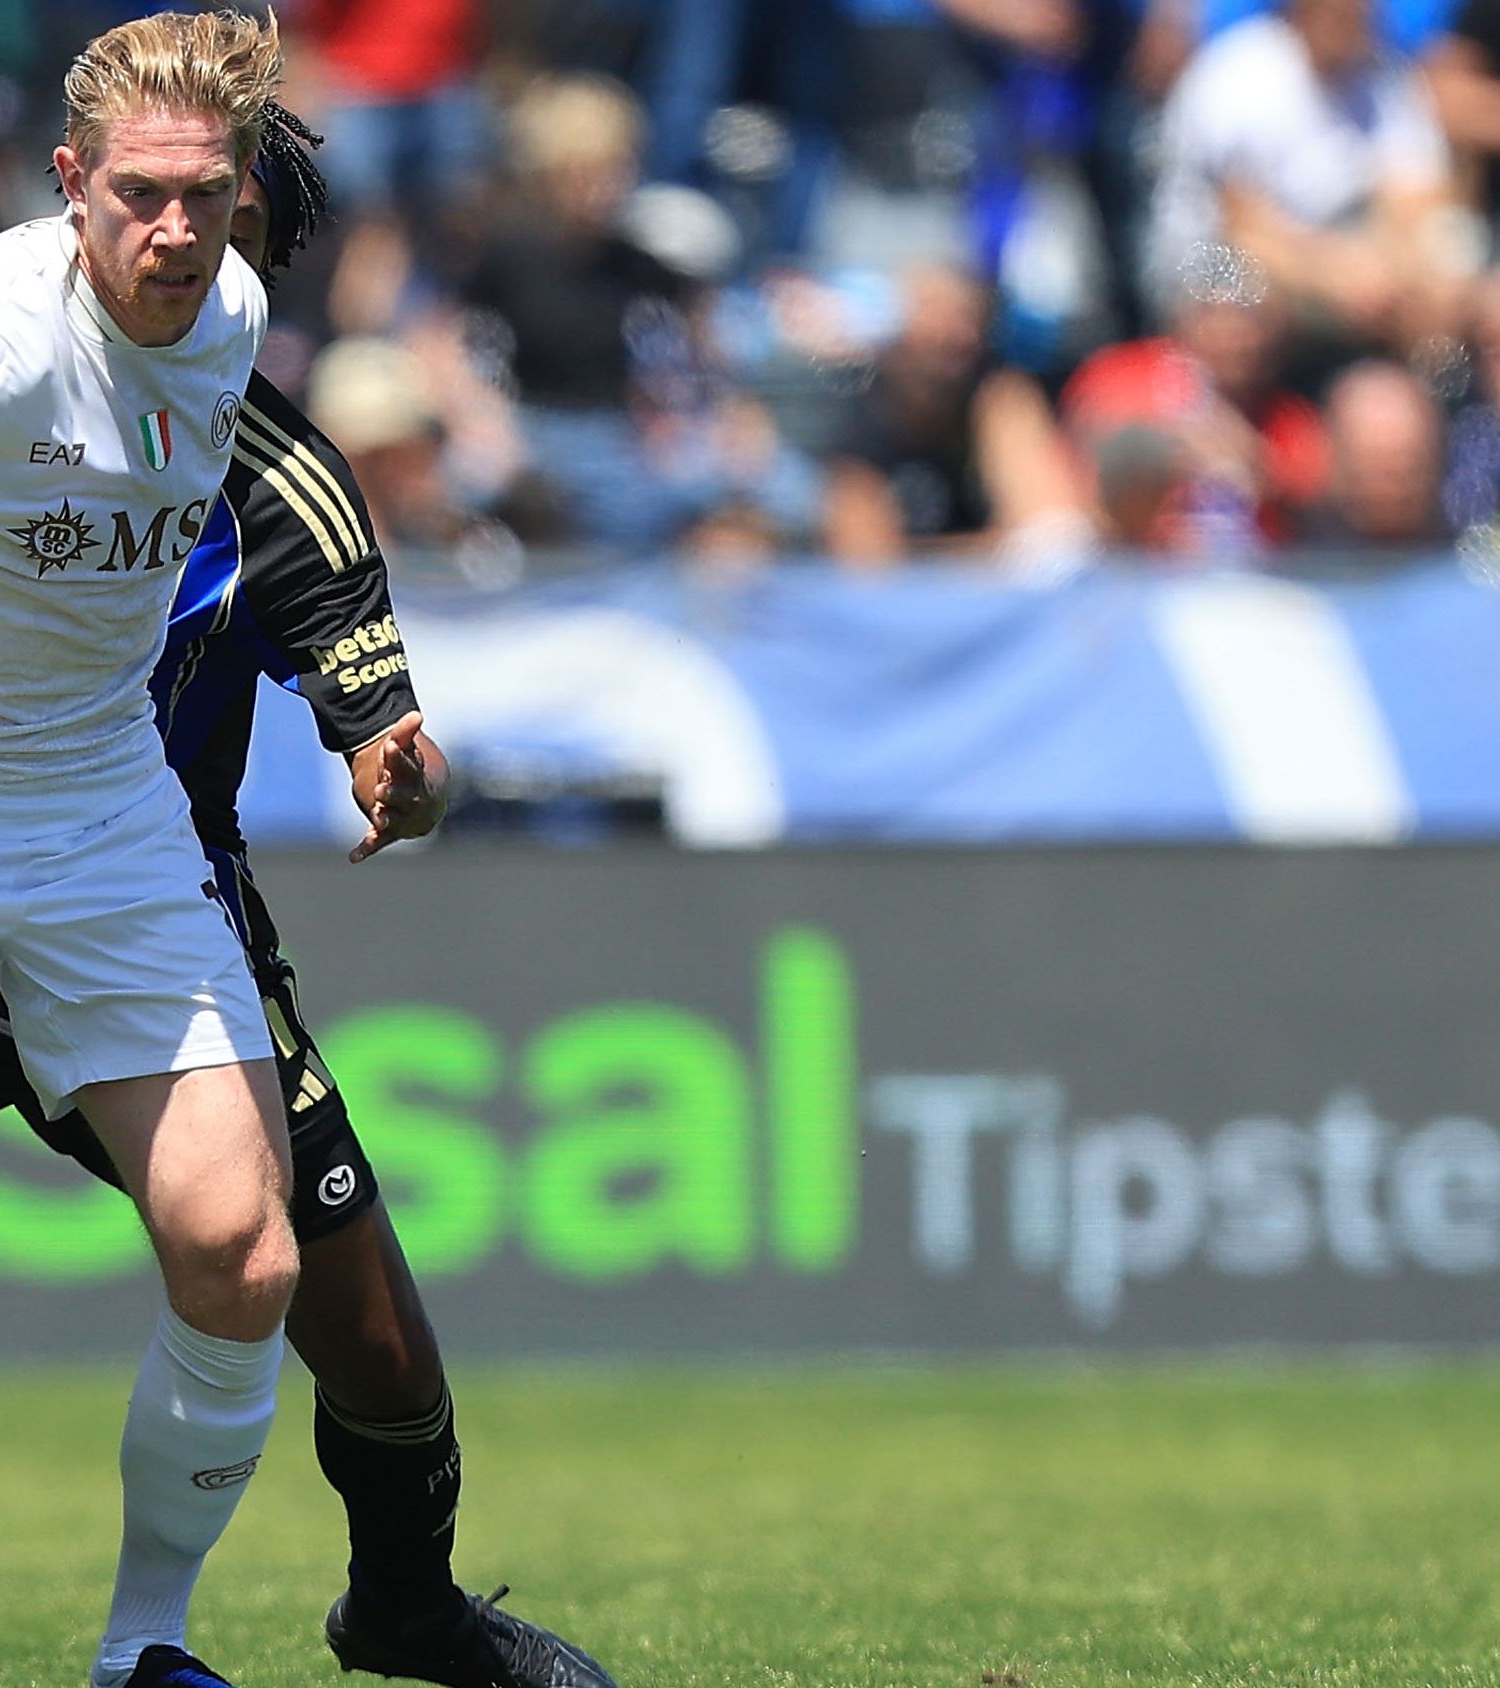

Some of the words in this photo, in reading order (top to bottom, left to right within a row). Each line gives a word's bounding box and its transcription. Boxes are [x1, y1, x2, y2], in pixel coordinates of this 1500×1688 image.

[28, 442, 86, 466] EA7
[96, 498, 208, 571] MS
[868, 1073, 1500, 1332] Tipste
